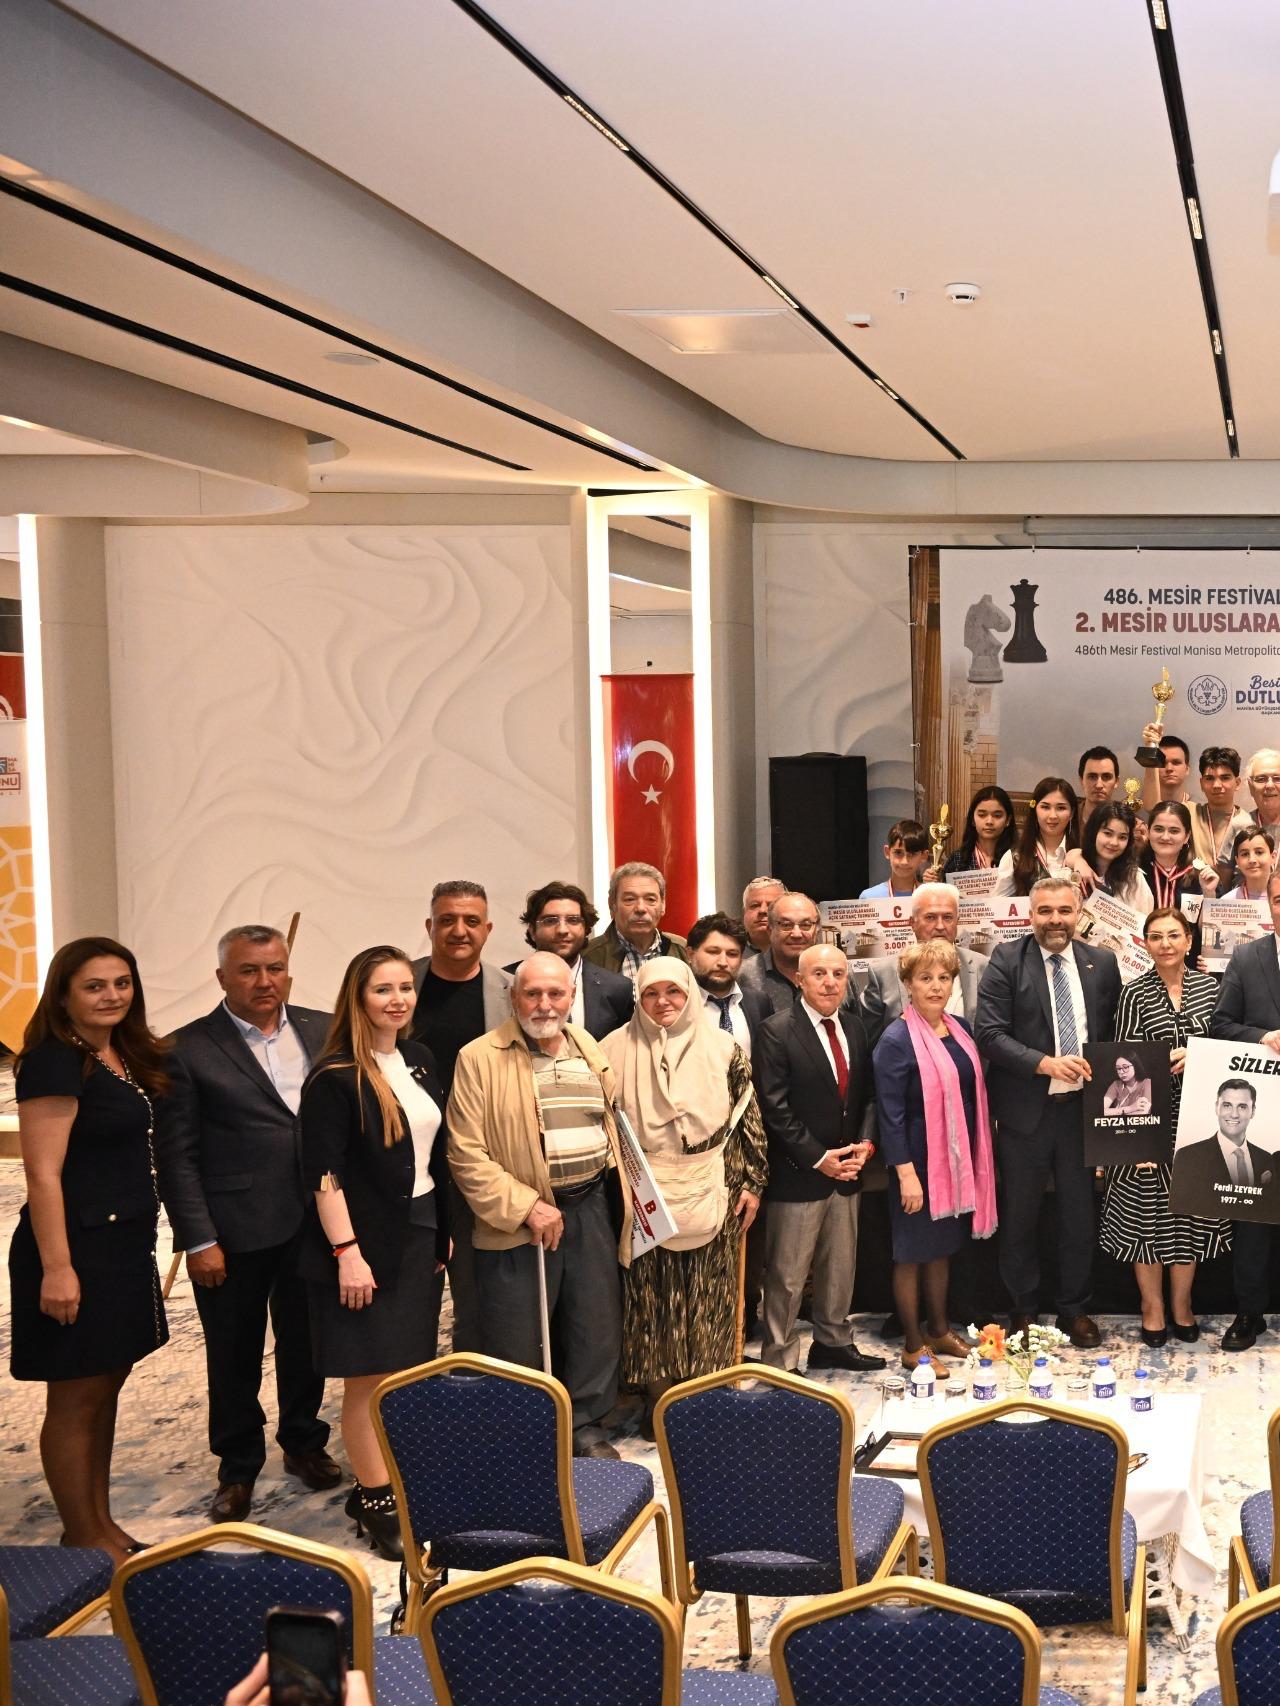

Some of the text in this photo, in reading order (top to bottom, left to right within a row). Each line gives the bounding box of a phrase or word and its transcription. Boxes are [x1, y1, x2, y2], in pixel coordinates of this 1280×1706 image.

[1104, 588, 1143, 605] 486.
[1148, 584, 1201, 605] MESİR
[1075, 612, 1095, 633] 2.
[1102, 606, 1167, 633] MESİR
[1075, 645, 1107, 656] 486th
[1110, 645, 1138, 656] Mesir
[1141, 645, 1181, 656] Festival
[1184, 645, 1222, 656] Manisa
[893, 905, 902, 919] C
[1008, 903, 1018, 917] A
[884, 941, 906, 950] 3.000
[1122, 955, 1145, 972] 10.000
[1094, 1114, 1160, 1127] FEYZA KESKİN
[1214, 1183, 1262, 1195] Ferdi ZEYREK
[1220, 1195, 1237, 1204] 1977
[644, 1199, 656, 1215] B
[1098, 1387, 1112, 1397] mila
[1135, 1401, 1149, 1410] mila
